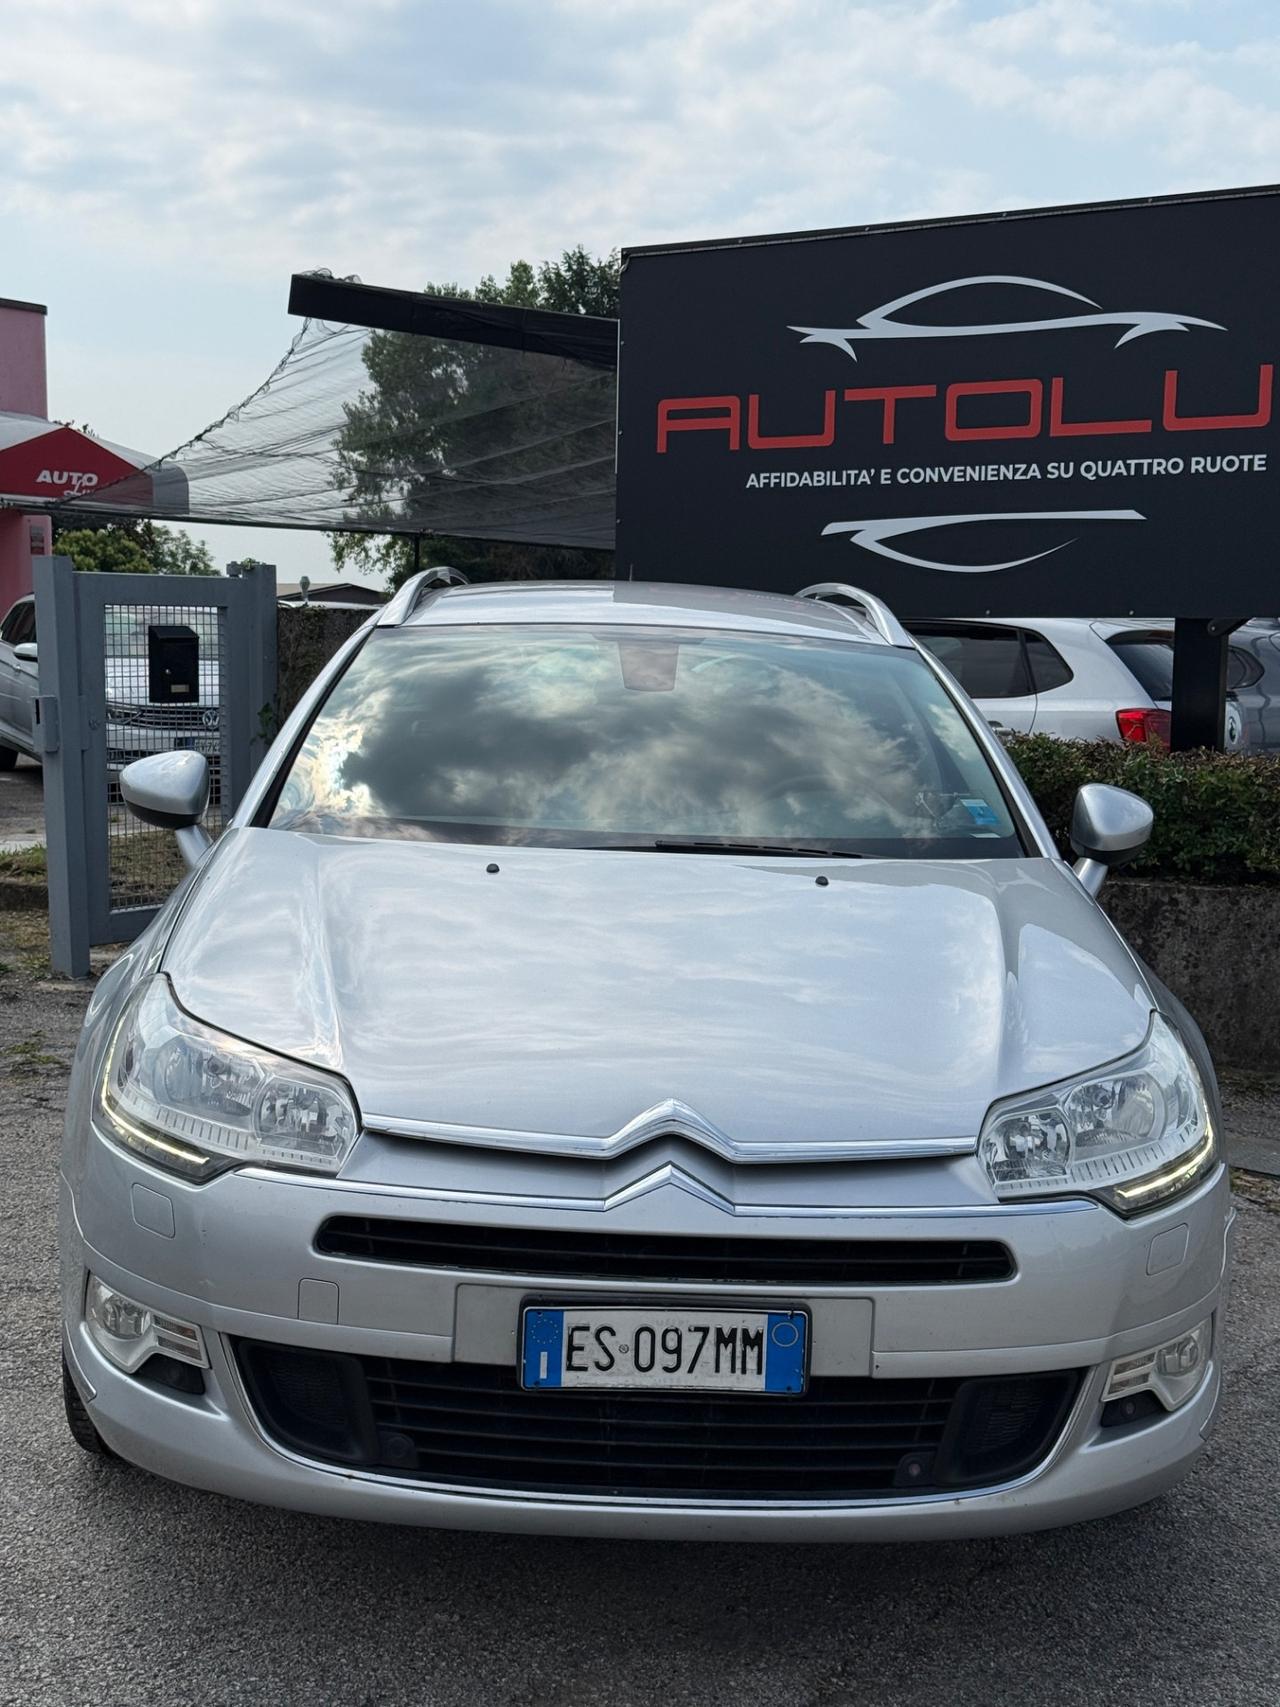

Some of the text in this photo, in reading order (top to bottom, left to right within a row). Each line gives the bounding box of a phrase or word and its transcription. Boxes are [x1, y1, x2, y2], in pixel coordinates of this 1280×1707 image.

[35, 469, 99, 487] AUTO
[880, 468, 892, 485] E
[896, 464, 1042, 485] CONVENIENZA
[1046, 462, 1074, 479] SU
[1079, 458, 1184, 480] QUATTRO
[1190, 454, 1267, 474] RUOTE
[565, 1325, 617, 1372] ES
[633, 1326, 764, 1376] 097MM
